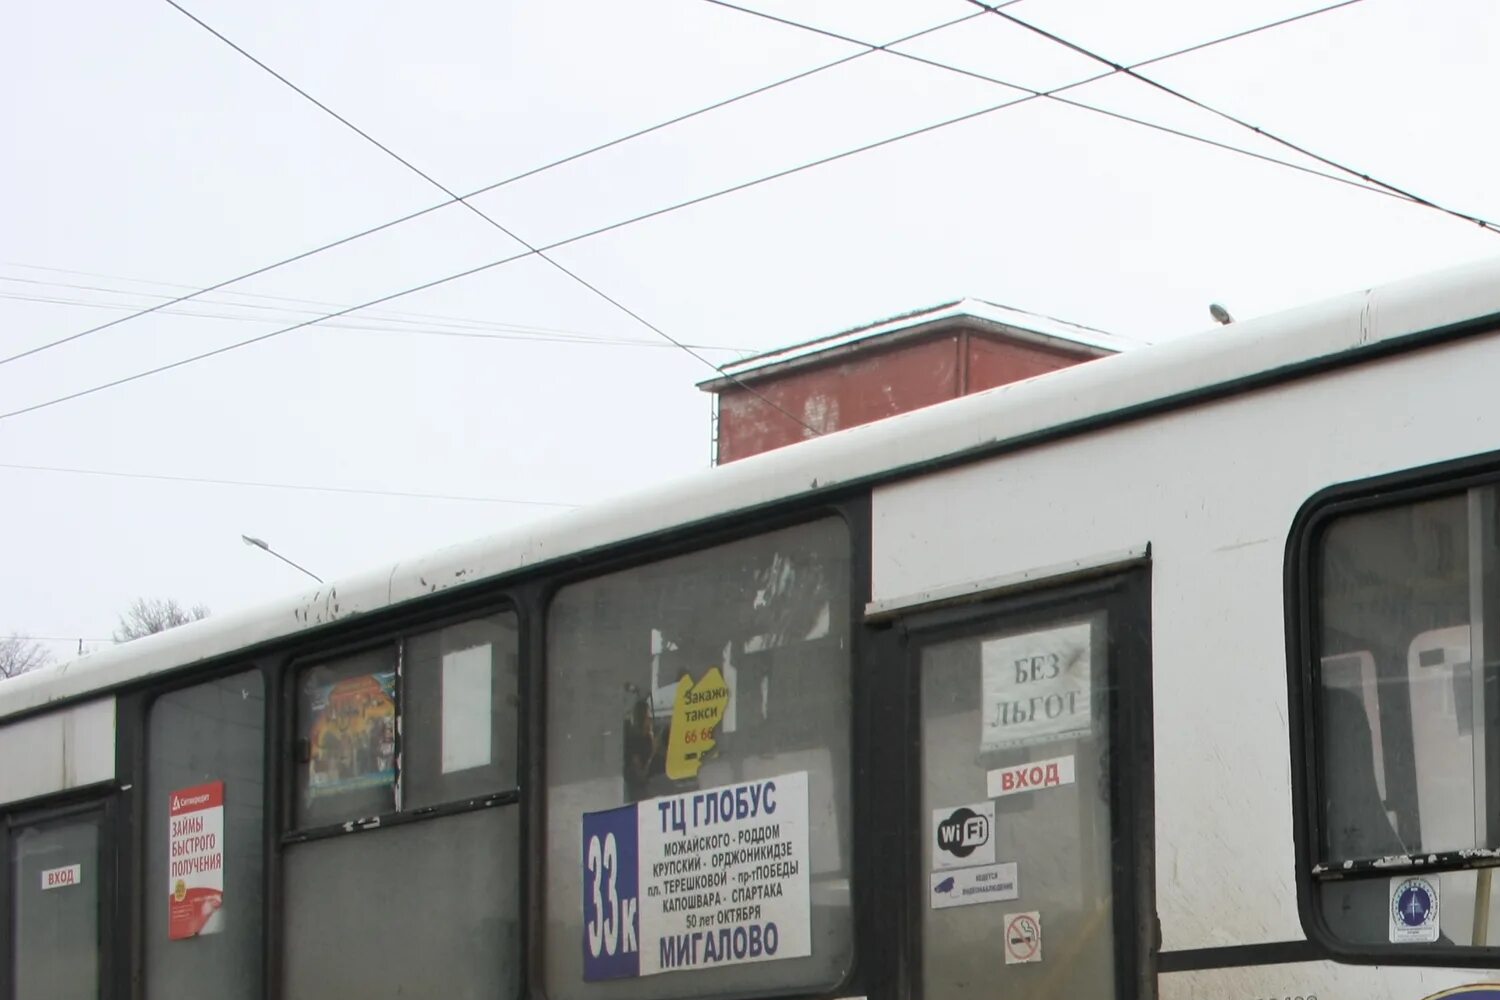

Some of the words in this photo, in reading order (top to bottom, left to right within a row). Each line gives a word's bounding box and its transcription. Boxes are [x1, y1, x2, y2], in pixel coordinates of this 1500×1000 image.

[1014, 653, 1060, 684] БЕЗ
[684, 687, 731, 705] Закажи
[991, 690, 1080, 728] ЛЬГОТ
[684, 707, 718, 722] такси
[1001, 763, 1060, 791] ВХОД
[658, 798, 686, 836] ТЦ
[693, 781, 777, 828] ГЛОБУС
[172, 816, 204, 837] ЗАЙМЫ
[172, 833, 216, 857] БЫСТРОГО
[664, 833, 730, 857] МОЖАЙСКОГО
[738, 824, 780, 845] РОДДОМ
[172, 853, 222, 877] ПОЛУЧЕНИЯ
[652, 854, 701, 877] КРУПСКИЙ
[711, 841, 792, 869] ОРДЖОНИКИДЗЕ
[48, 869, 75, 885] ВХОД
[648, 886, 661, 897] пл.
[664, 870, 727, 895] ТЕРЕШКОВОЙ
[662, 892, 721, 913] КАПОШВАРА
[732, 882, 783, 903] СПАРТАКА
[686, 914, 697, 929] 50
[699, 915, 714, 927] лет
[717, 905, 761, 924] ОКТЯБРЯ
[659, 922, 779, 968] МИГАЛОВО
